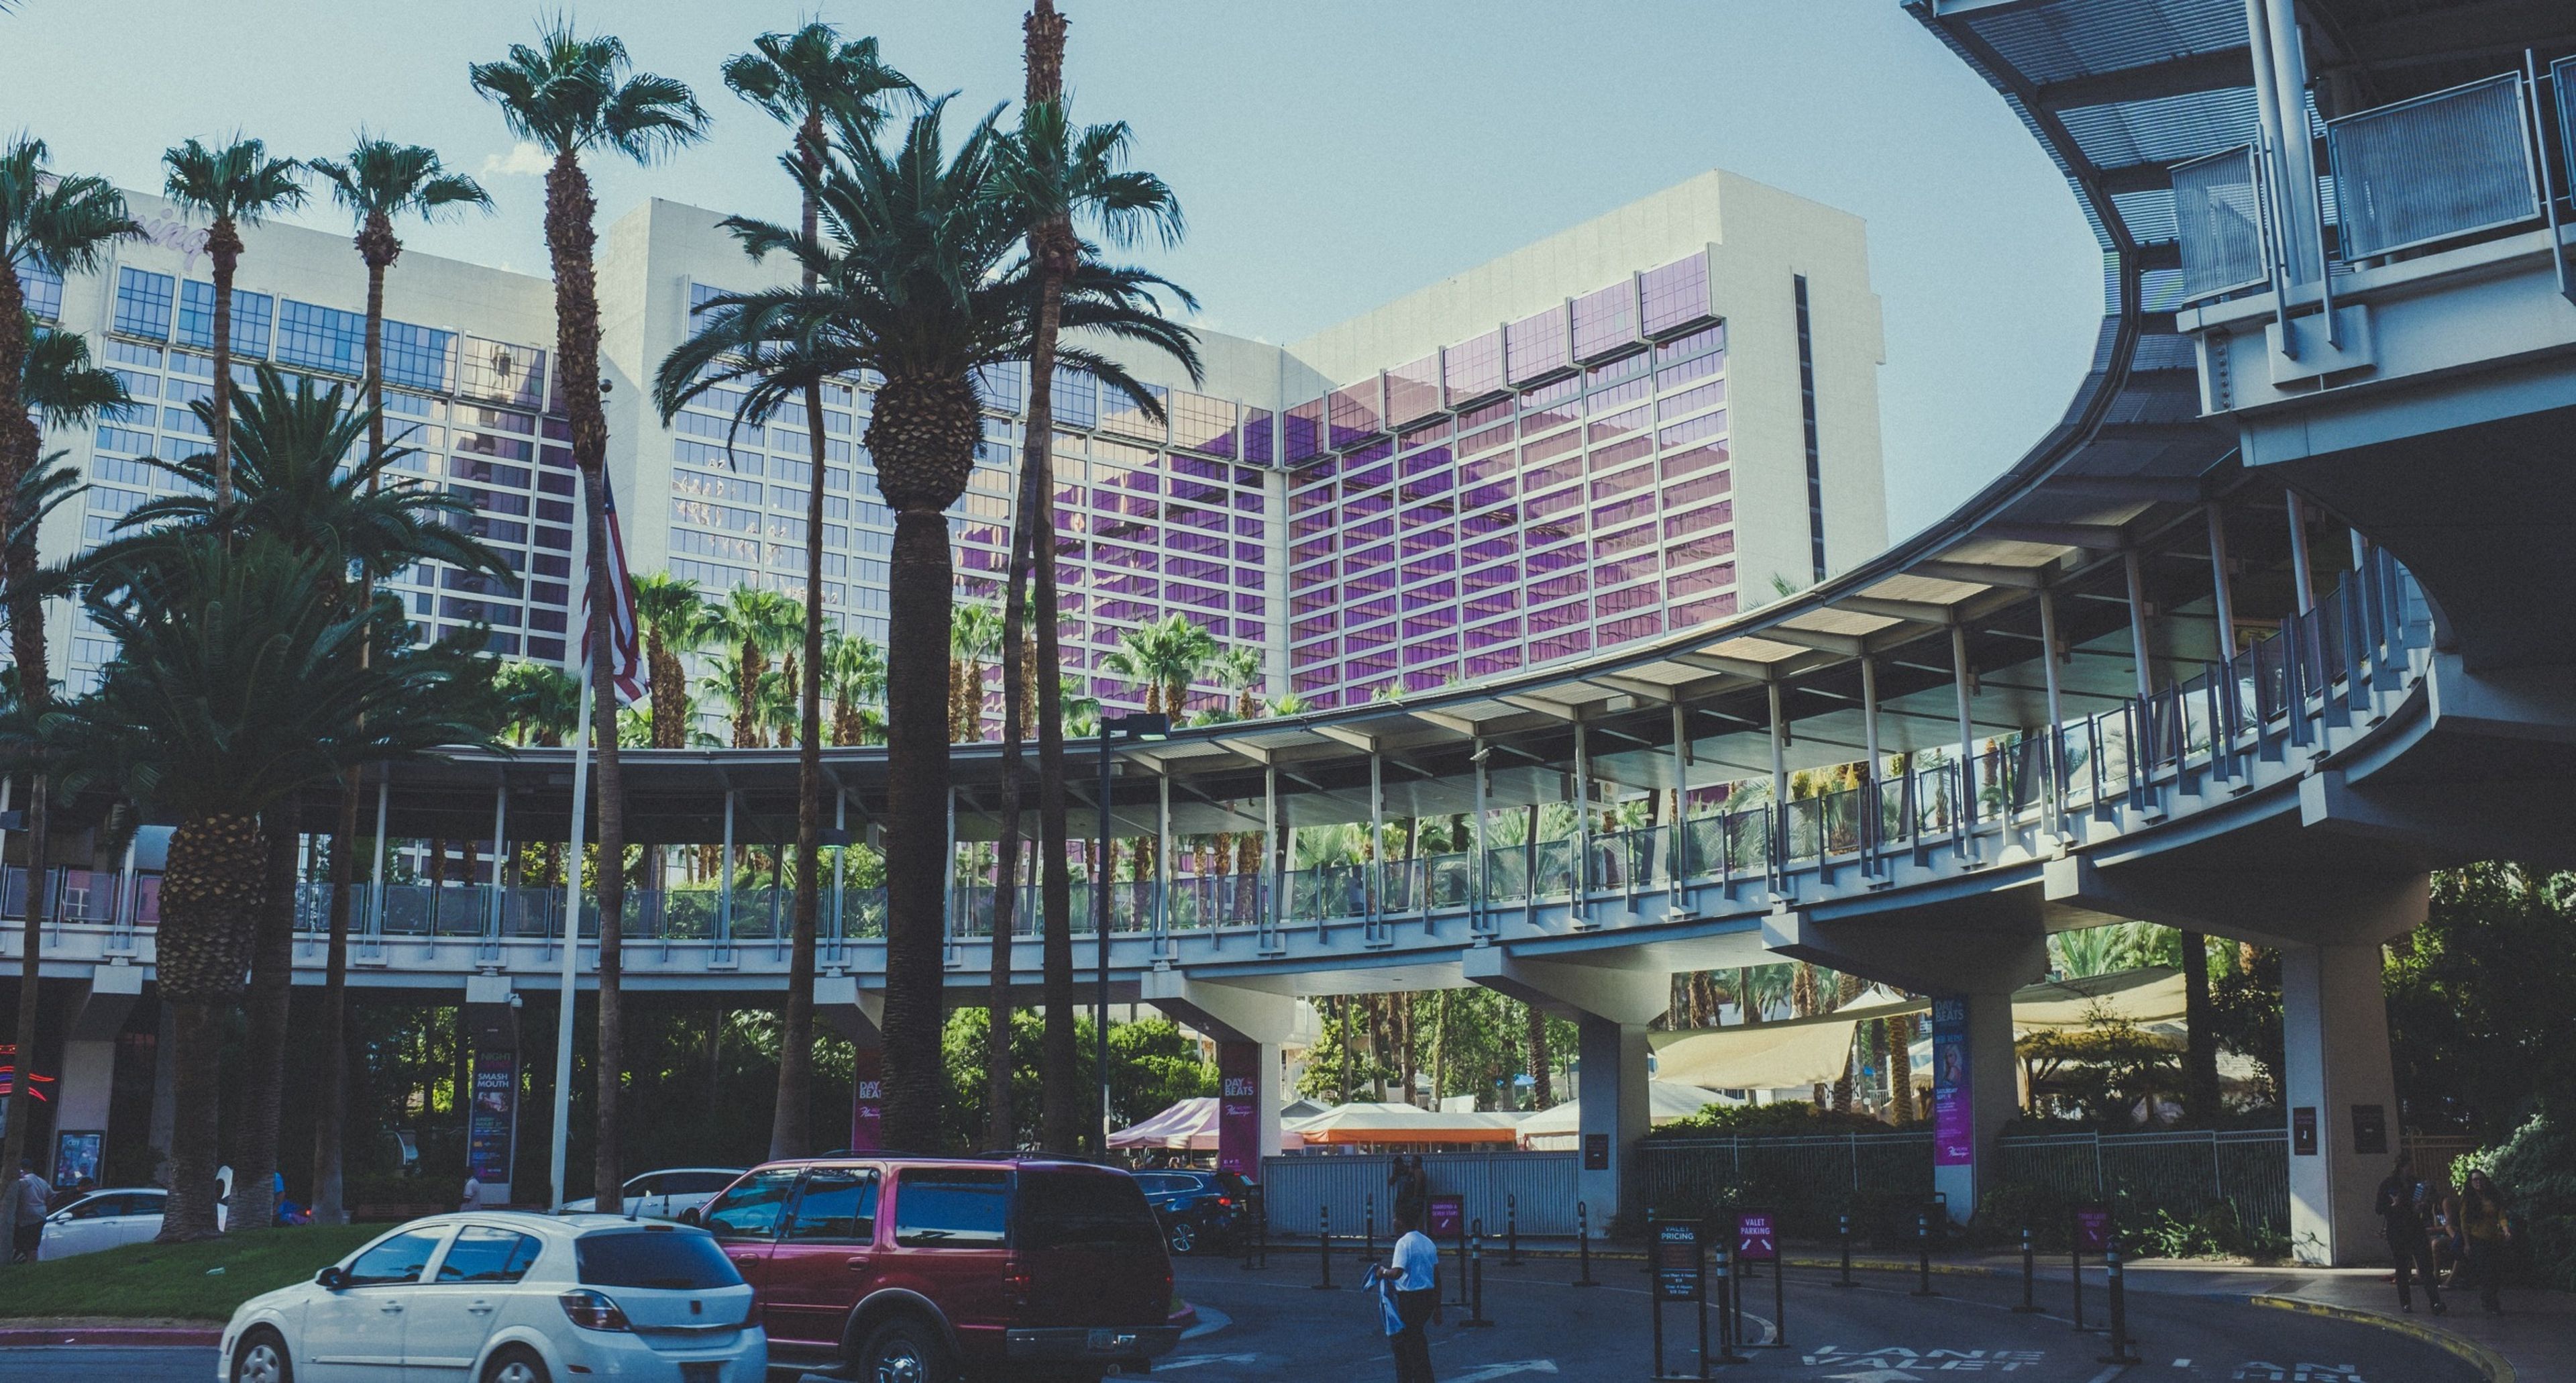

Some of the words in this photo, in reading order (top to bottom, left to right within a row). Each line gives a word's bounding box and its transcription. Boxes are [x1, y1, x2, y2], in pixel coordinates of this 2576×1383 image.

[1935, 1000, 1954, 1011] DAY
[1935, 1009, 1964, 1022] BEATS
[859, 1081, 880, 1090] DAY
[1225, 1078, 1244, 1087] DAY
[1225, 1086, 1254, 1096] BEATS
[1745, 1218, 1764, 1226] VALET
[1813, 1345, 2045, 1360] LANE
[1801, 1355, 2039, 1372] VALET
